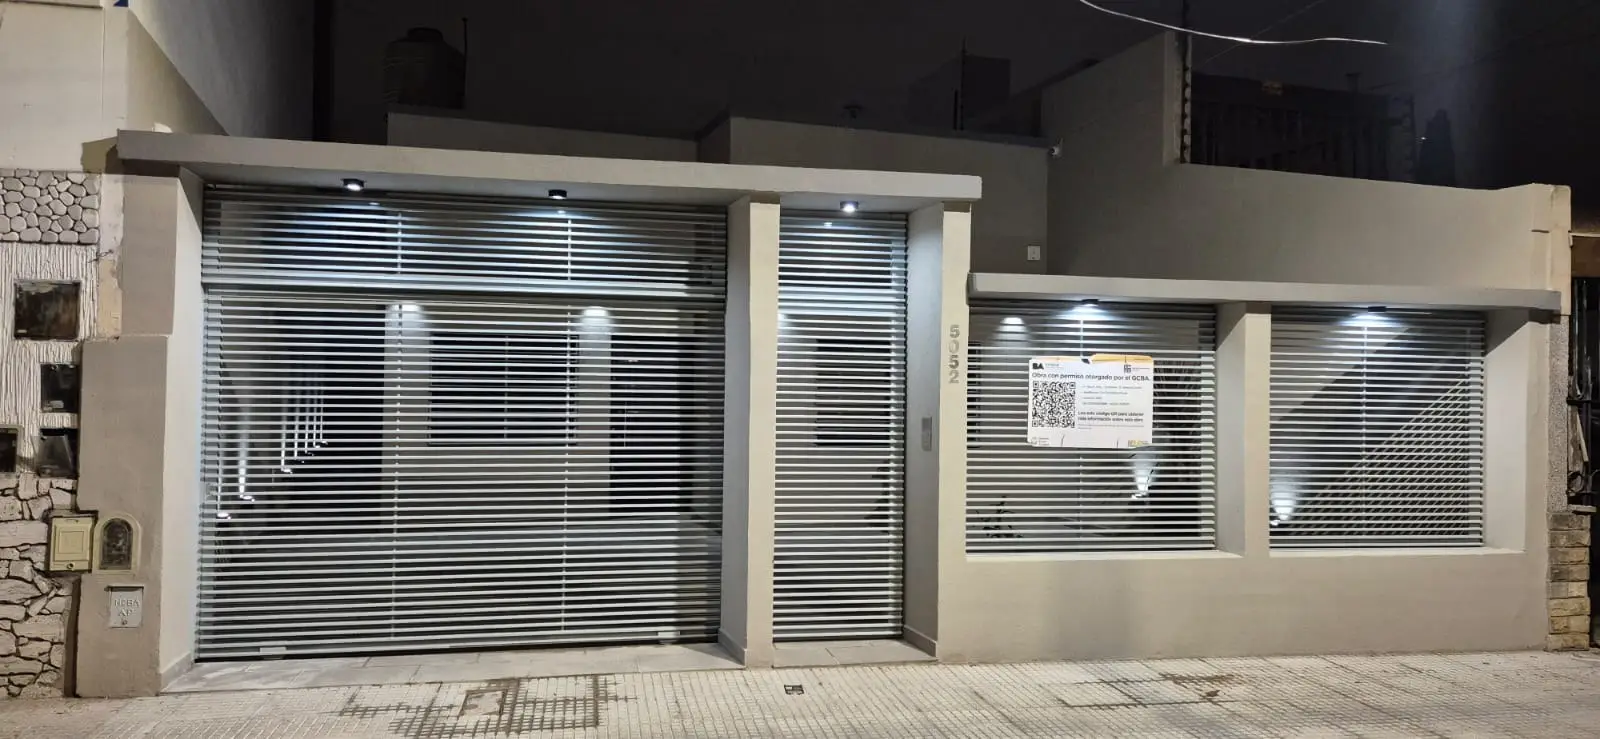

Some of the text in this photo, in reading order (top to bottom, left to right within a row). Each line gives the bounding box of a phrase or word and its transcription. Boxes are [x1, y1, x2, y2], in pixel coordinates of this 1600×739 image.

[949, 324, 960, 384] 5052
[1032, 362, 1044, 370] BA
[1060, 373, 1084, 381] permiso
[1086, 373, 1112, 382] otorgado
